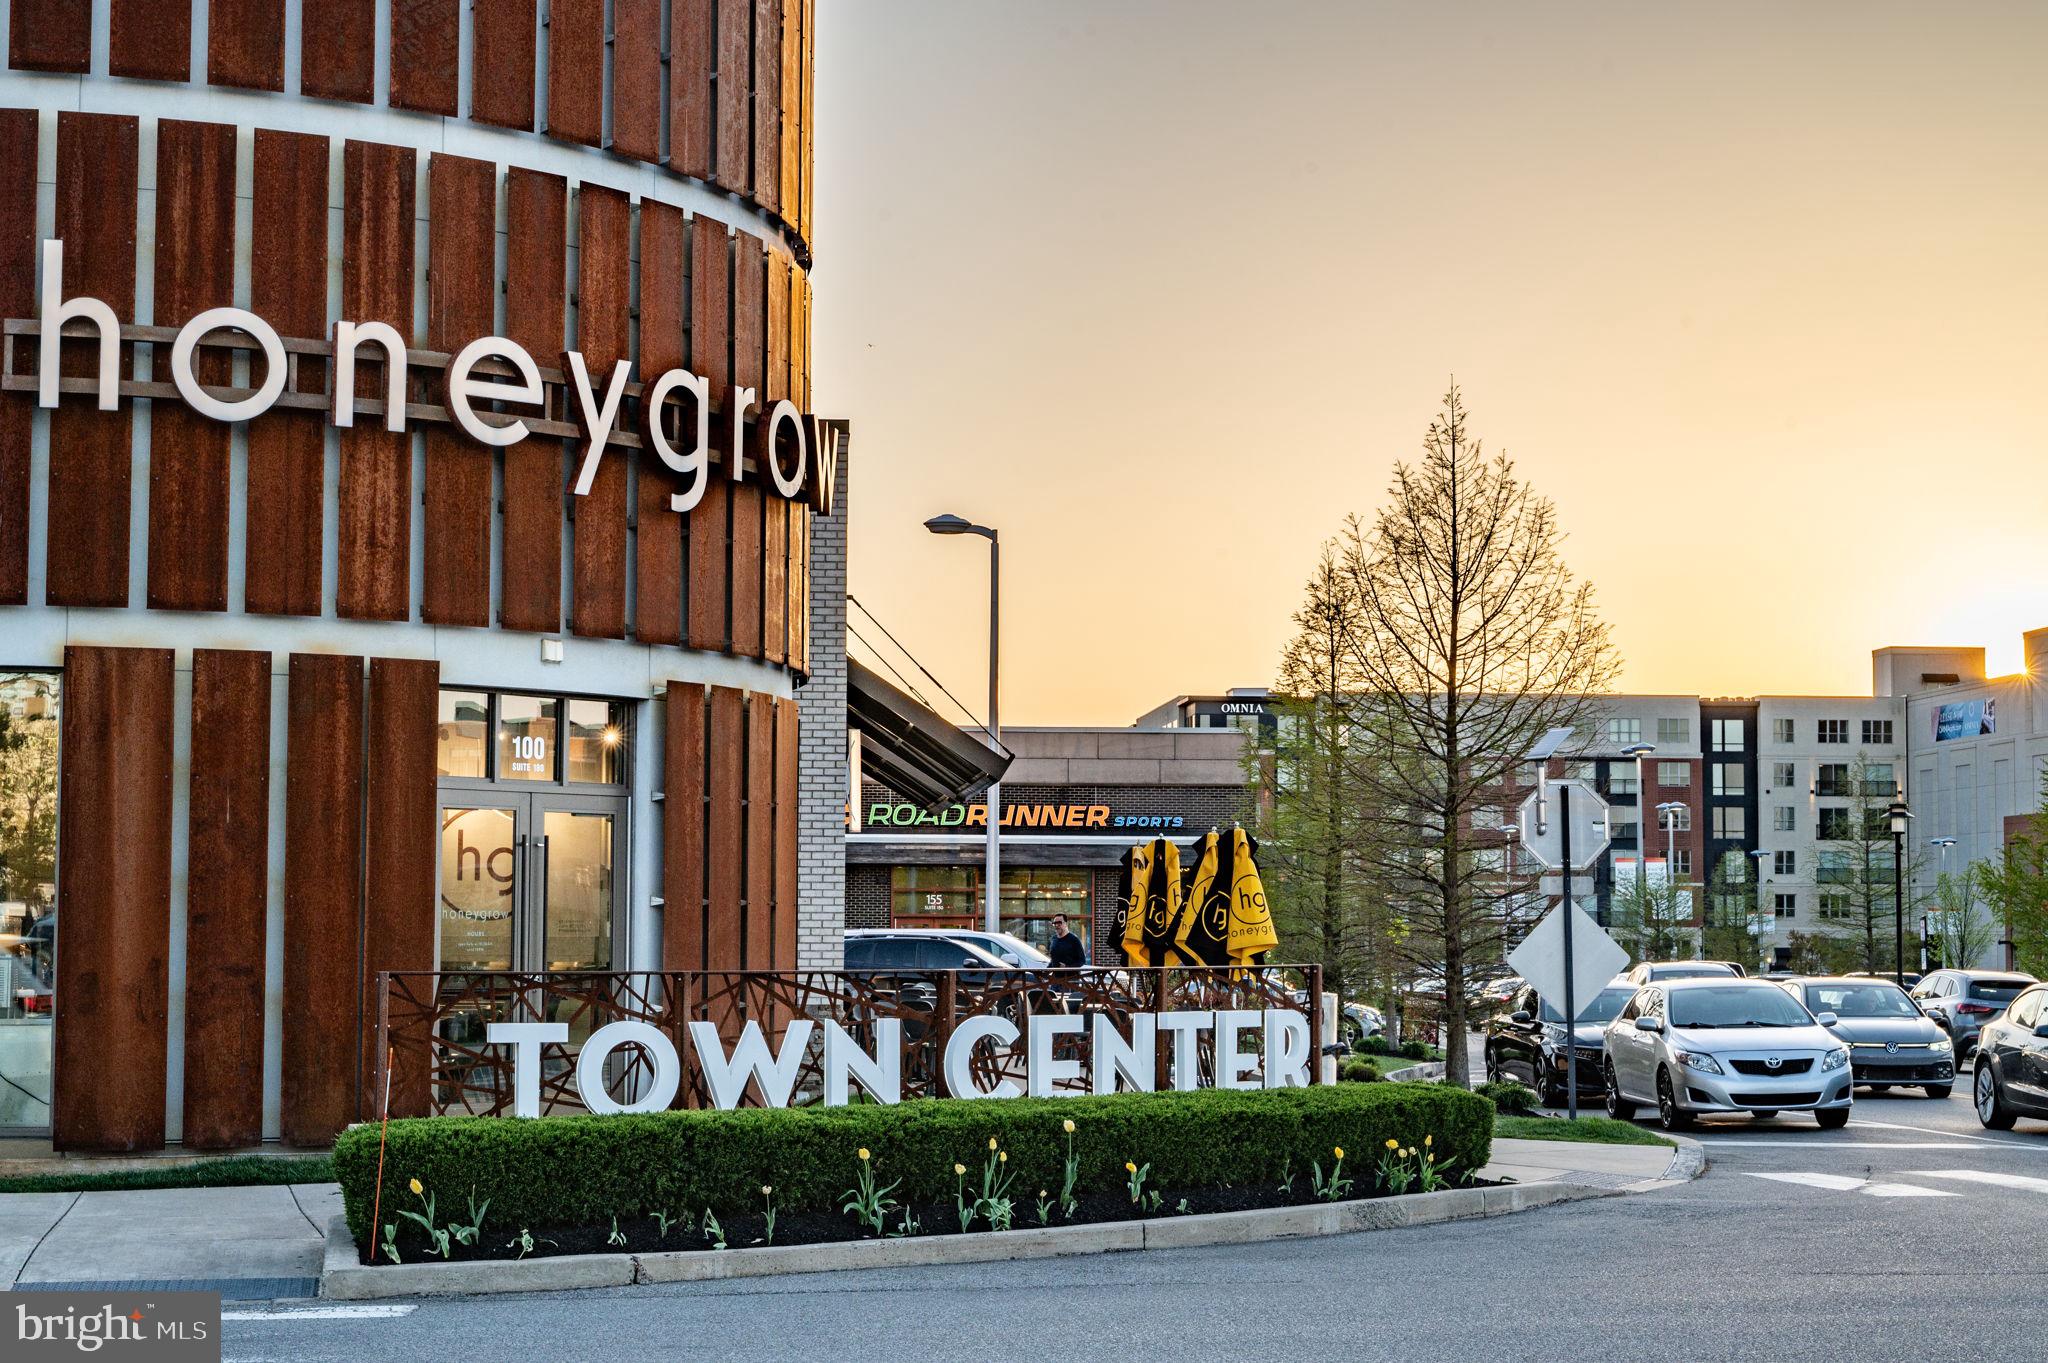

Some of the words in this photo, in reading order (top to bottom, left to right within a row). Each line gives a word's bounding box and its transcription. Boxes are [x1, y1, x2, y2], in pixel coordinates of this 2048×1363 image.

[38, 238, 840, 518] honeygrow
[1221, 703, 1264, 713] OMNIA
[512, 735, 545, 760] 100
[512, 762, 530, 771] SUITE
[1114, 816, 1184, 828] SPORTS
[926, 894, 943, 905] 155
[1239, 887, 1266, 913] hg
[442, 906, 510, 923] honeygrow
[486, 1017, 902, 1120] TOWN
[943, 1009, 1311, 1098] CENTER
